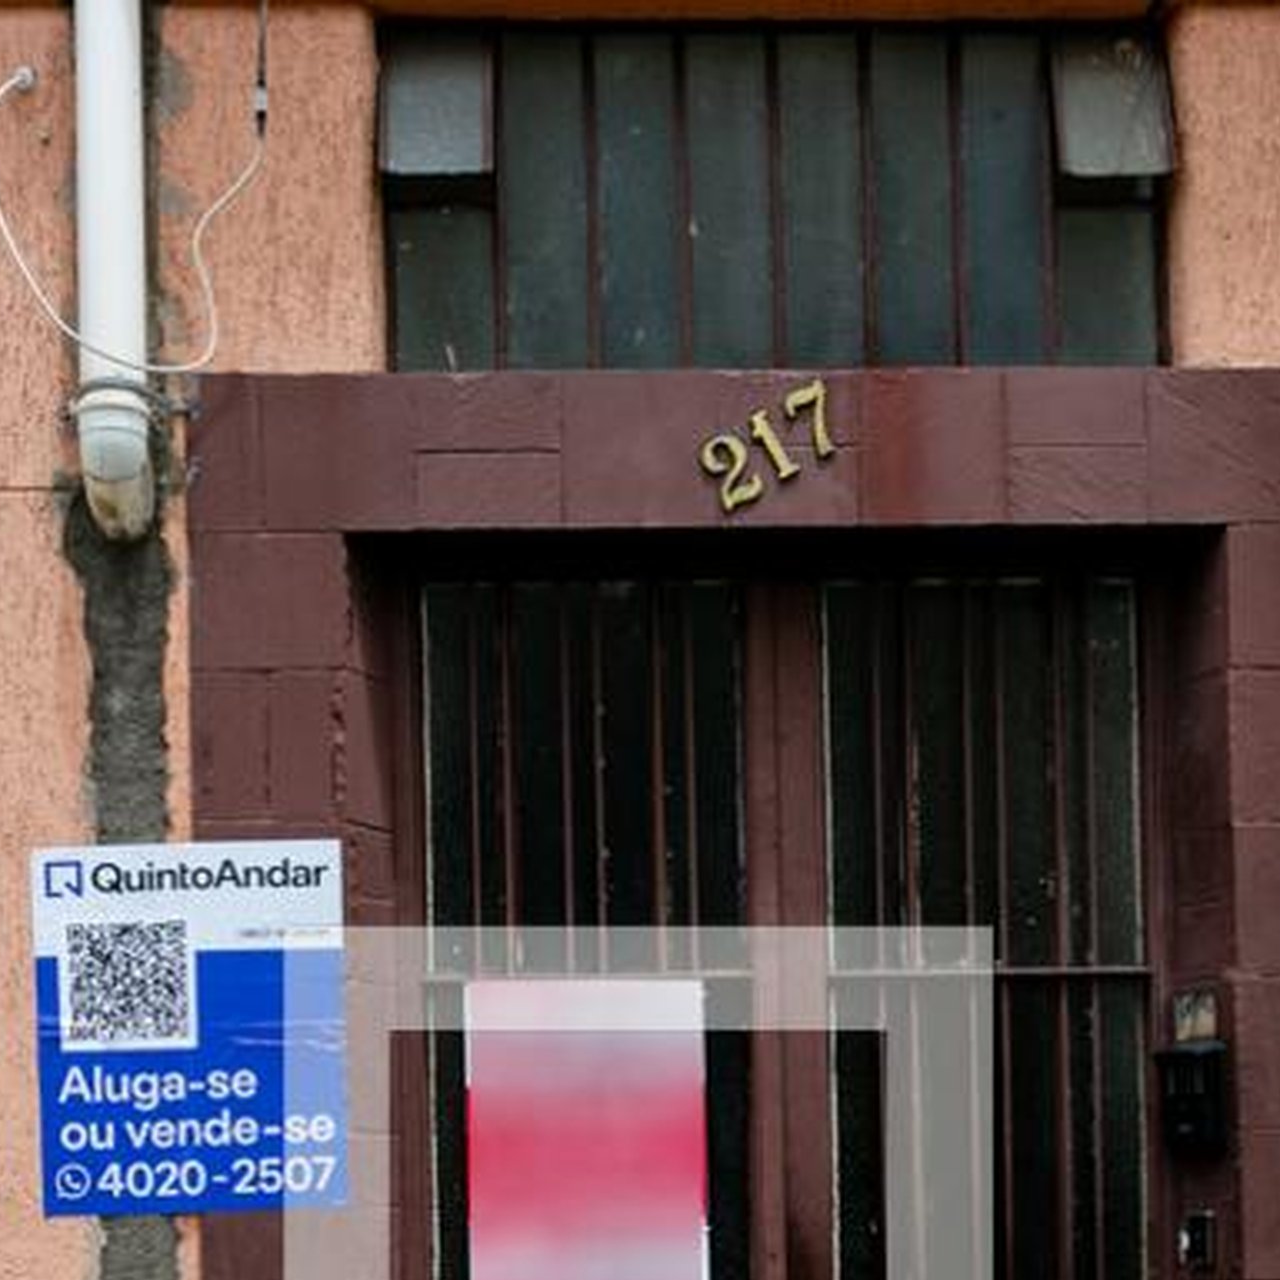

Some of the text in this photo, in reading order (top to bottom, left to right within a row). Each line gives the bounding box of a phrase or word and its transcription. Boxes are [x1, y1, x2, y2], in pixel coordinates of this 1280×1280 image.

[699, 379, 832, 512] 217
[90, 856, 329, 894] QuintoAndar
[58, 1065, 258, 1111] Aluga-se
[59, 1108, 336, 1151] ou vende-se
[97, 1155, 337, 1197] 4020-2507
